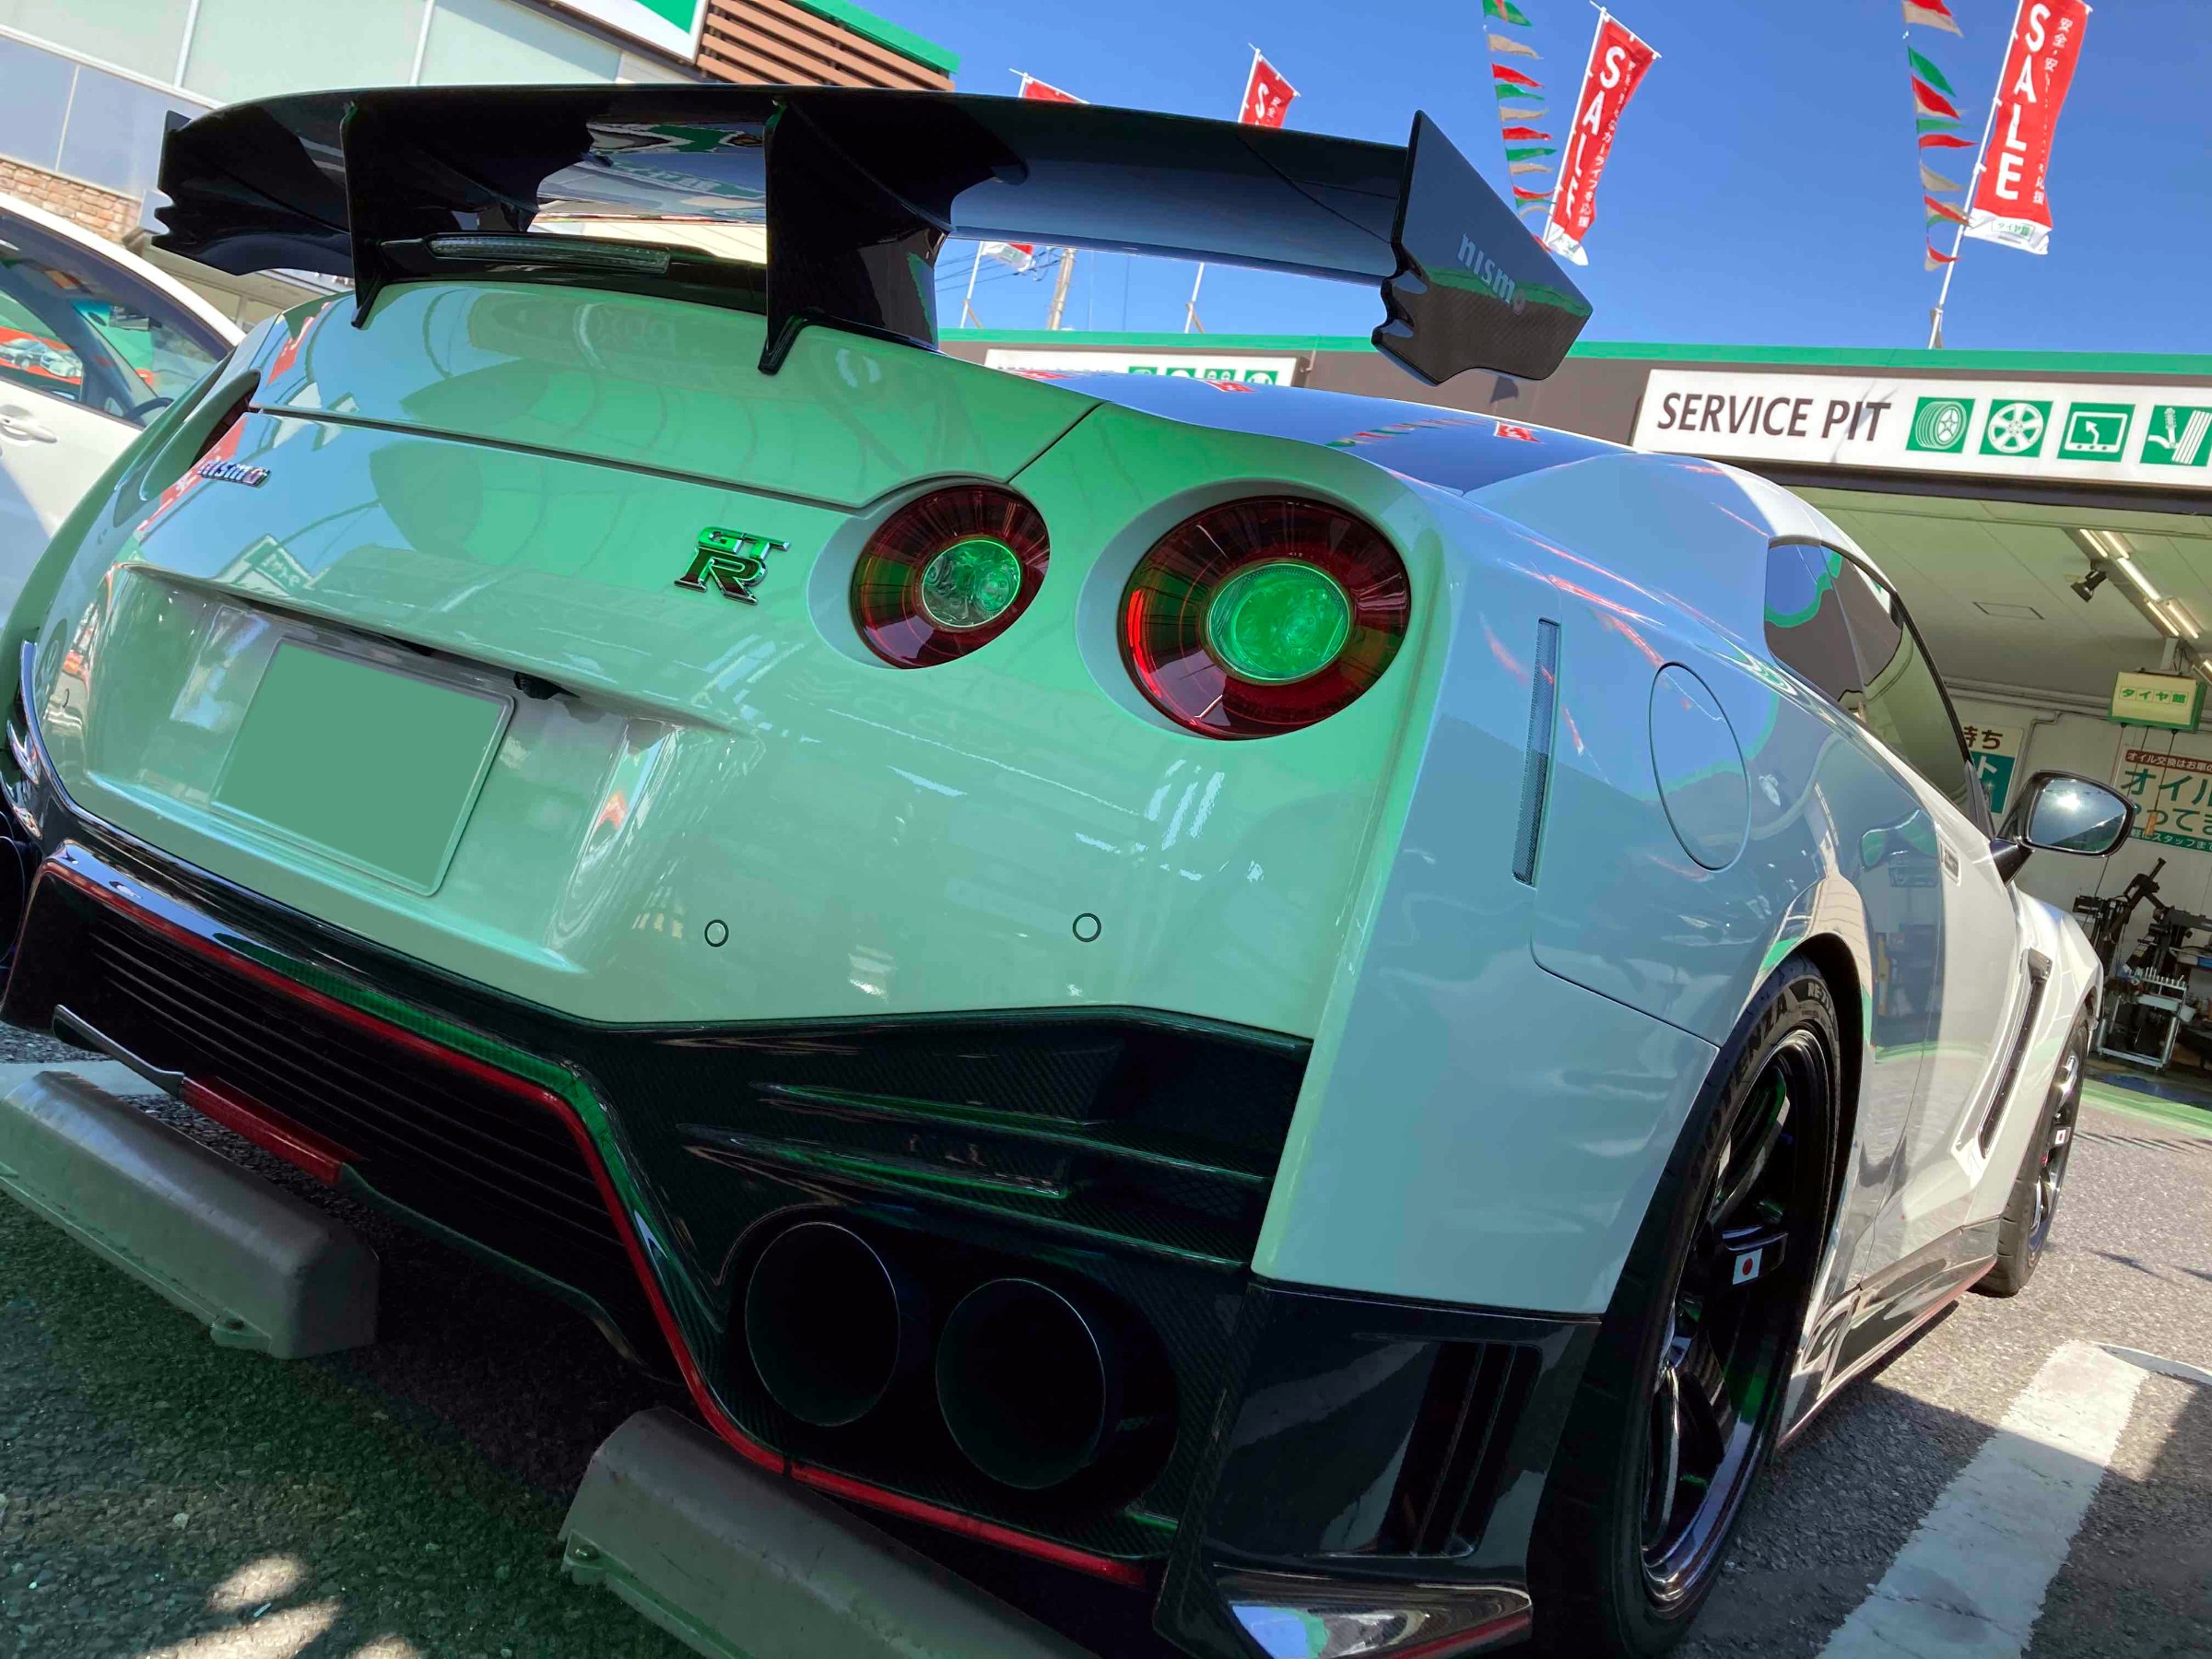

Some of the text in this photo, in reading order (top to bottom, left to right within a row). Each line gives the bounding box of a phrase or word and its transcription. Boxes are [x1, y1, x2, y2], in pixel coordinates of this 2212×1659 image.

[1995, 3, 2051, 200] SALE
[1458, 233, 1526, 315] nismo
[1657, 392, 1892, 441] SERVICE PIT
[197, 460, 269, 488] nismo
